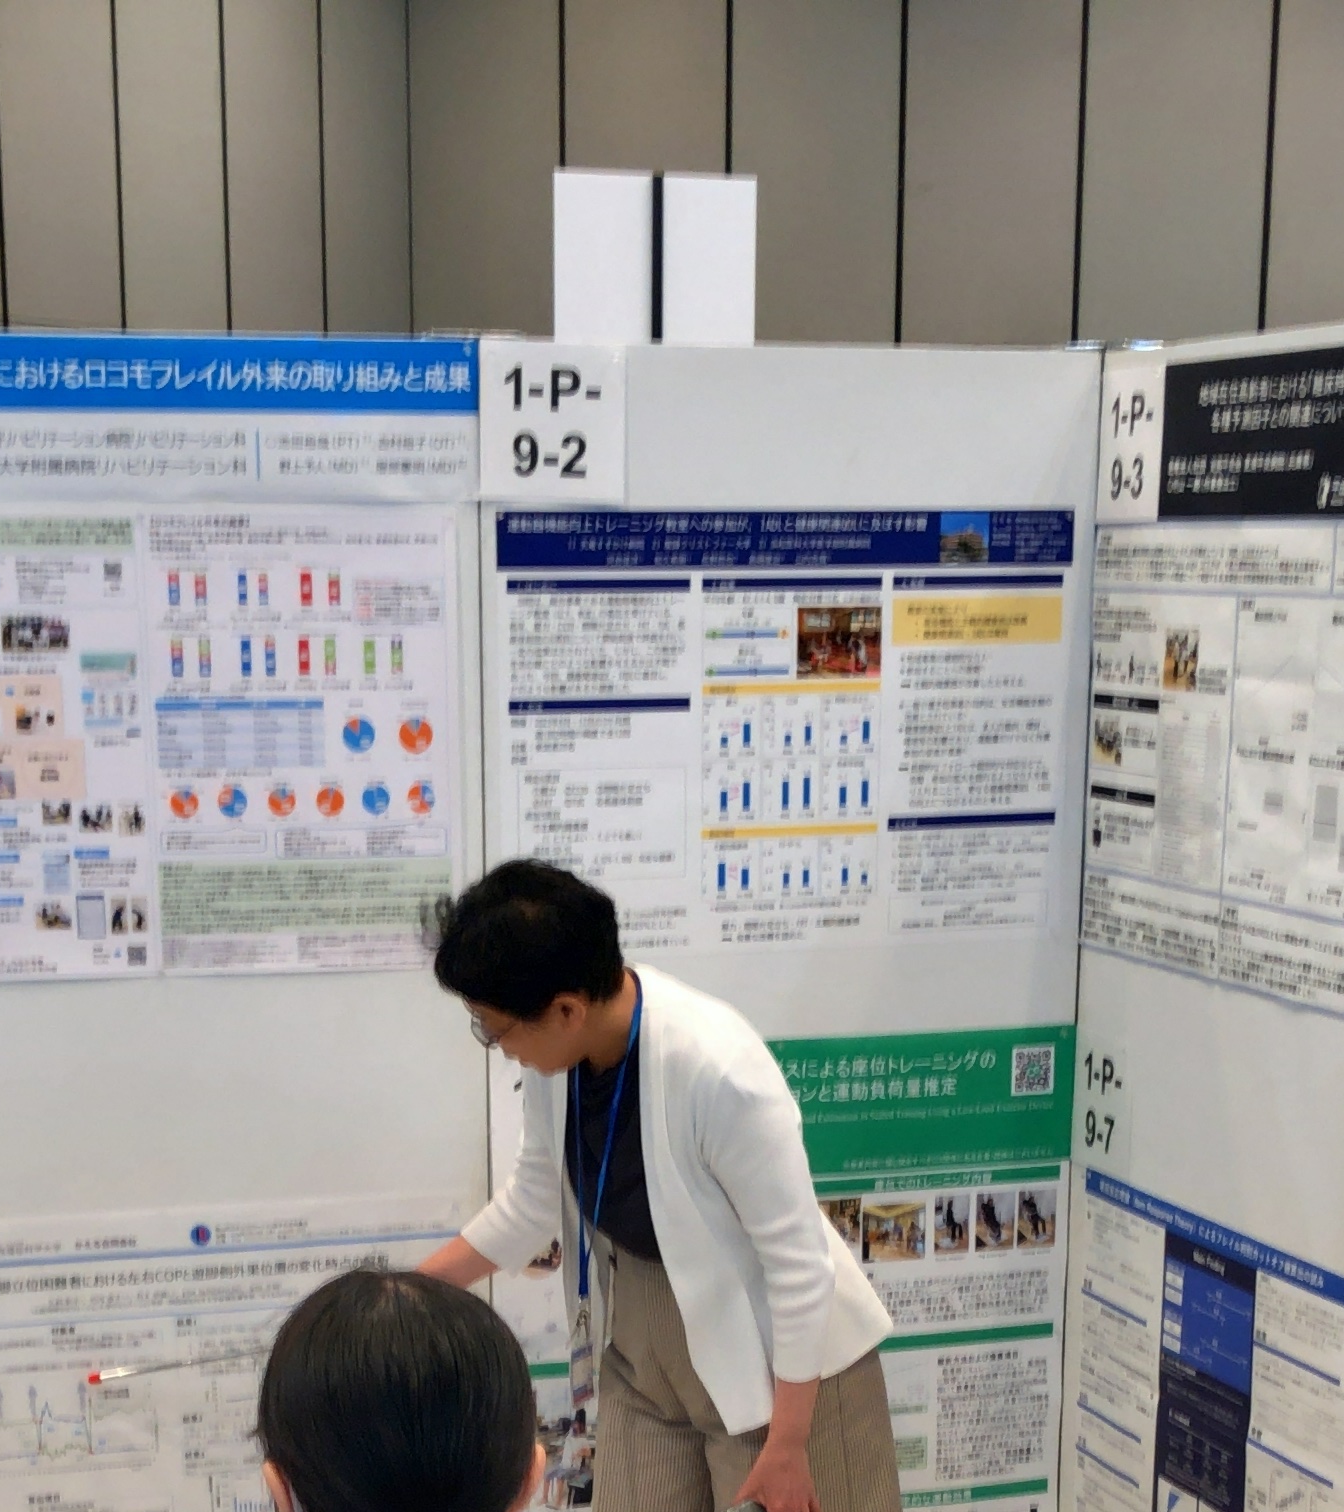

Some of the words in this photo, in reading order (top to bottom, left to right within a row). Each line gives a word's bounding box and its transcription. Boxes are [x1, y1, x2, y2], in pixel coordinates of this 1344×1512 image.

[503, 362, 602, 412] 1-P-
[1111, 391, 1154, 437] 1-P-
[512, 430, 589, 479] 9-2
[1110, 455, 1145, 500] 9-3
[1084, 1053, 1122, 1095] 1-P-
[1084, 1109, 1115, 1154] 9-7
